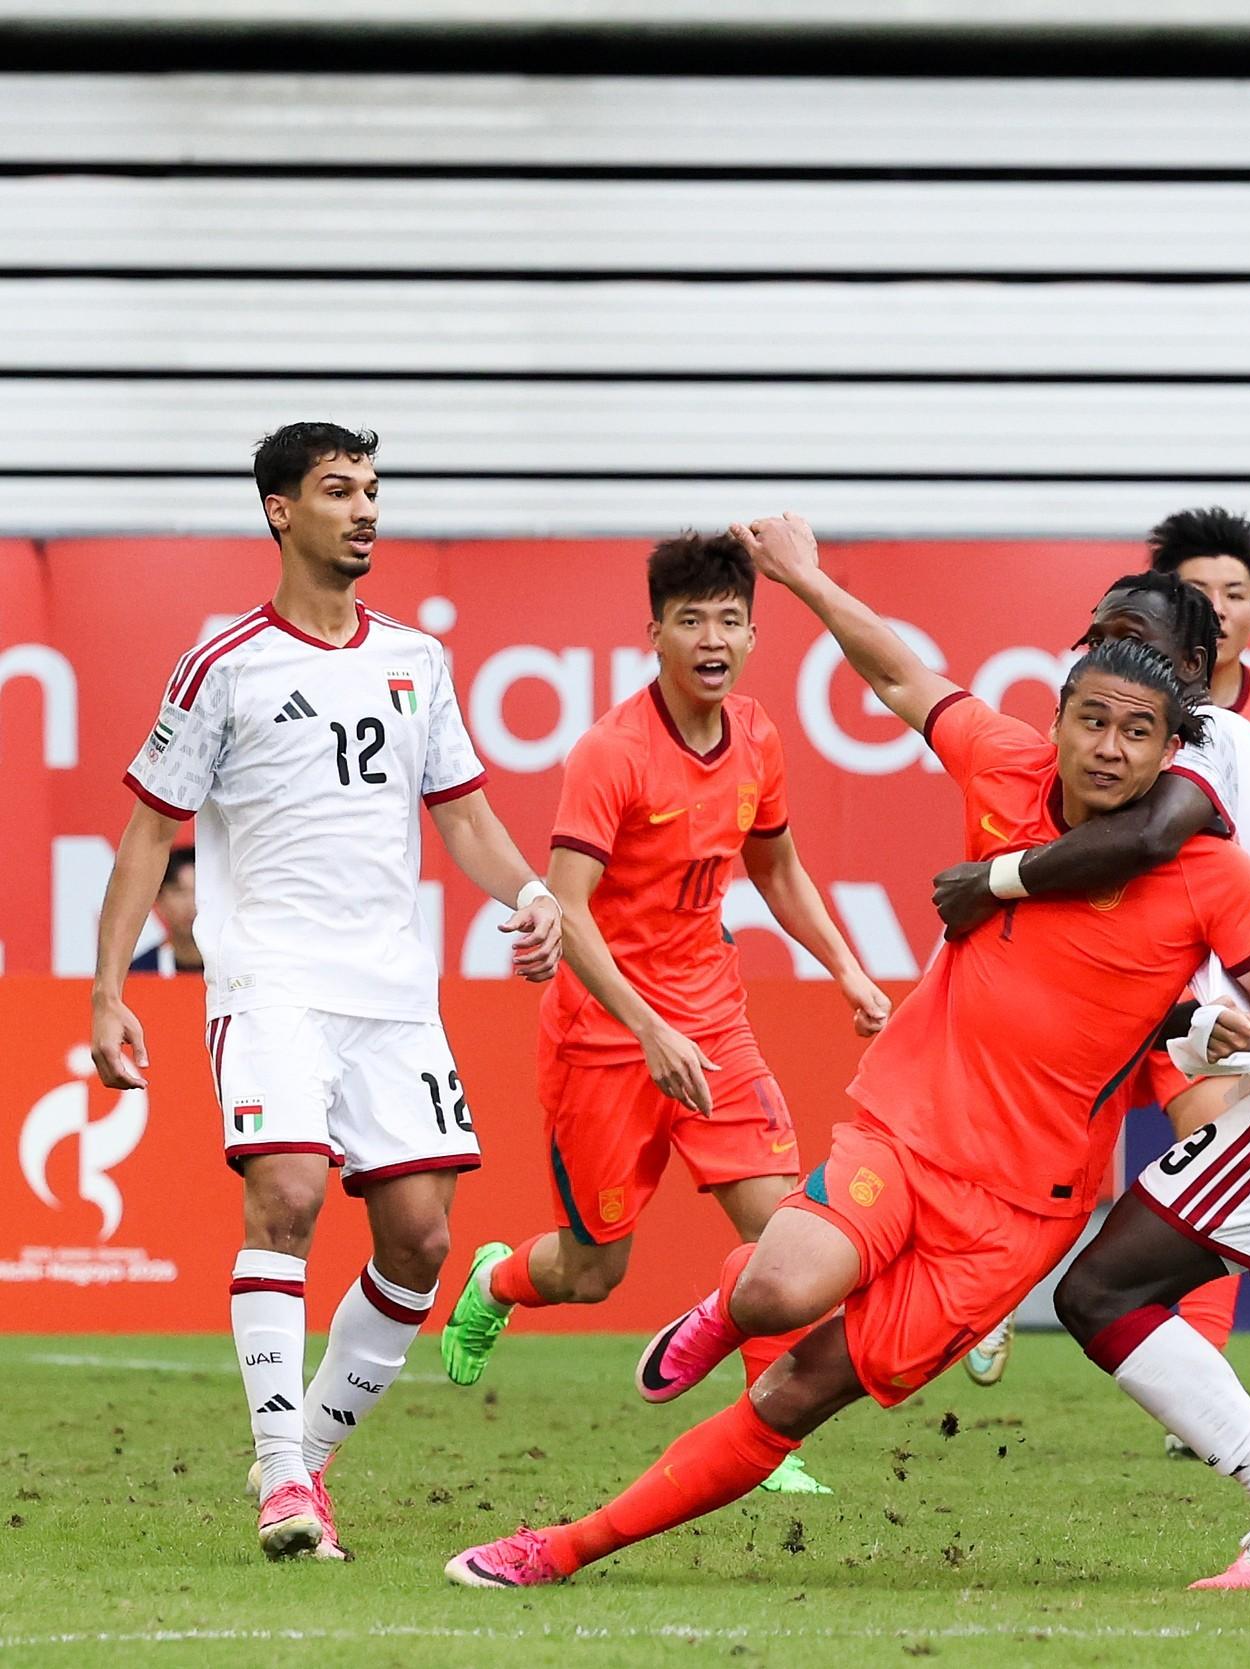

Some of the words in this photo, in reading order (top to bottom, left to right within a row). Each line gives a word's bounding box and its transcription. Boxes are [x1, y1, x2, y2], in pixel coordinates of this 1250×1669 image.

[330, 716, 388, 787] 12
[672, 855, 723, 913] 10
[1159, 1122, 1217, 1176] 3
[245, 1351, 283, 1366] UAE
[347, 1371, 384, 1394] UAE
